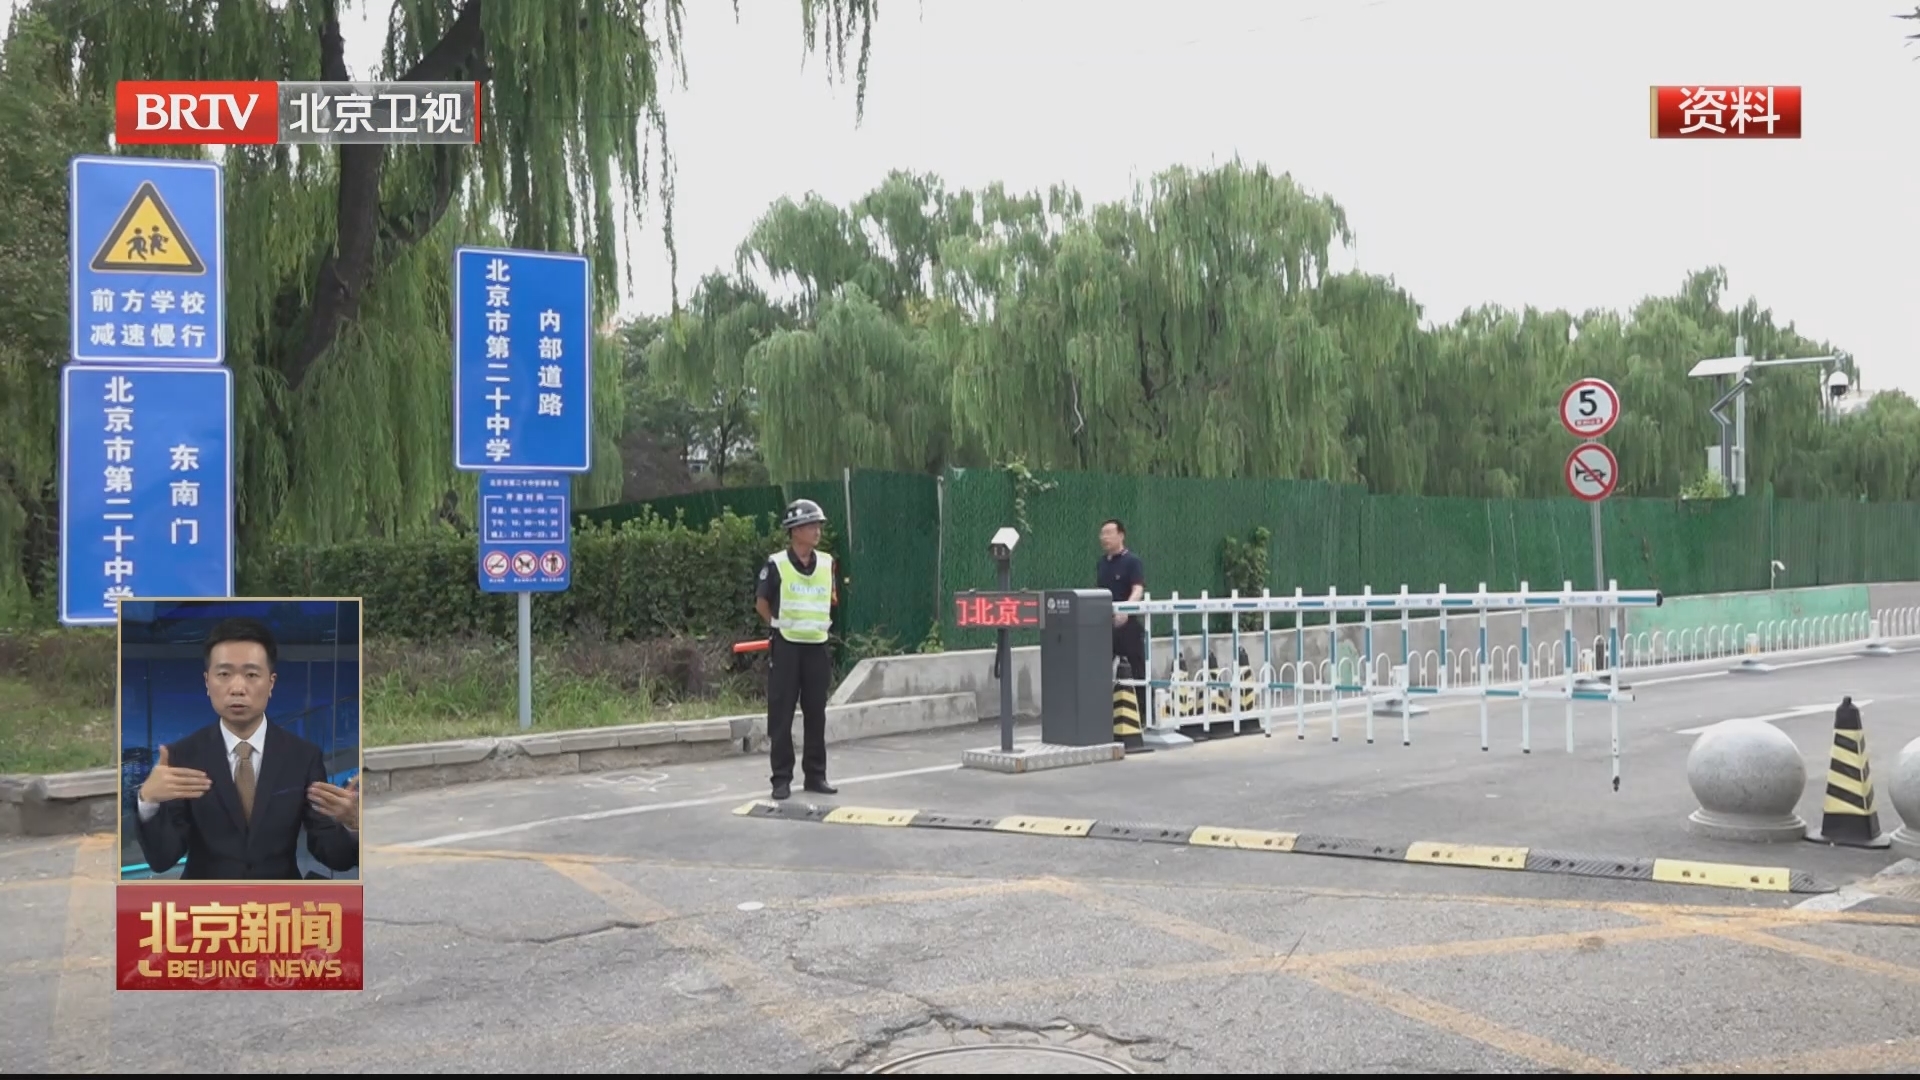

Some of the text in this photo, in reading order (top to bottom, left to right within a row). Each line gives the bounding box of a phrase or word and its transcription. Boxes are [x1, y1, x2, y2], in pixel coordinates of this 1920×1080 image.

[90, 288, 206, 315] 前方学校
[90, 322, 206, 348] 减速慢行
[485, 258, 511, 462] 北京市第二十中学
[538, 308, 563, 416] 内部道路
[1579, 389, 1597, 416] 5
[169, 444, 200, 545] 东南门
